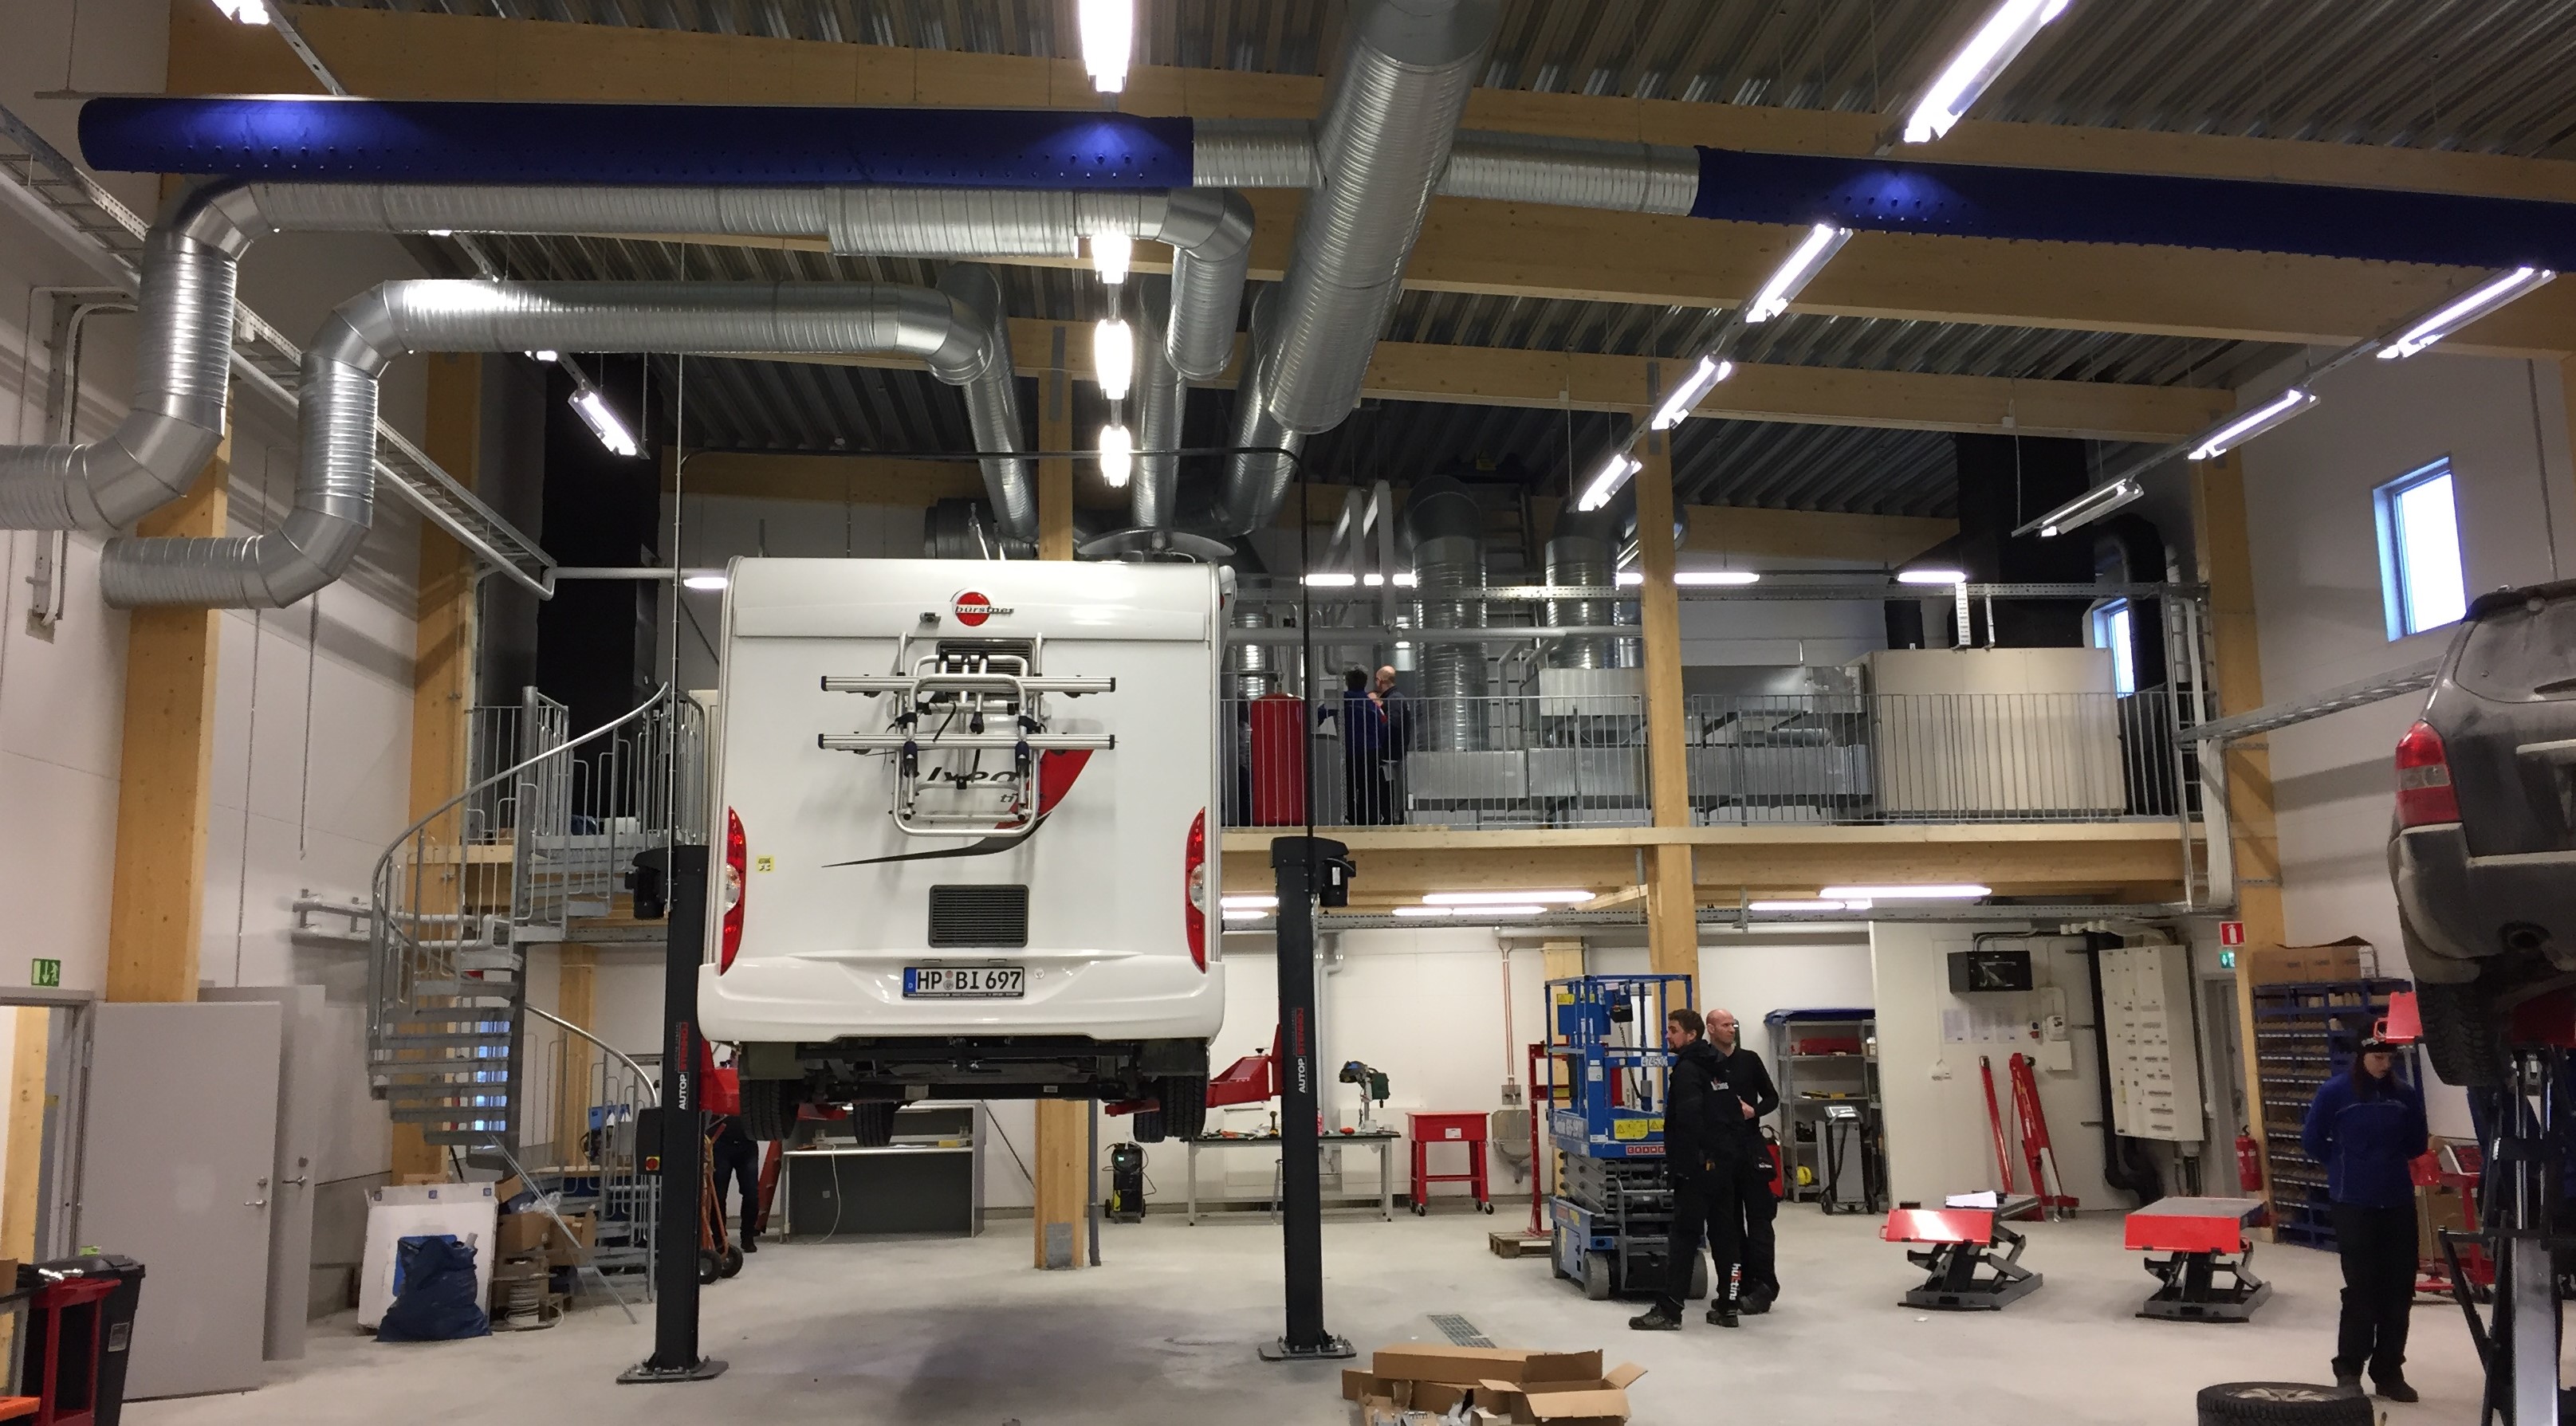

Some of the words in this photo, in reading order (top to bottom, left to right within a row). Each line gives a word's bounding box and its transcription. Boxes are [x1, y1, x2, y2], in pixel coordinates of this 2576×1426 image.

[917, 971, 942, 989] HP
[955, 971, 980, 989] BI
[985, 971, 1021, 989] 697
[678, 1074, 687, 1110] AUTOP
[1627, 1145, 1666, 1154] CRAMO
